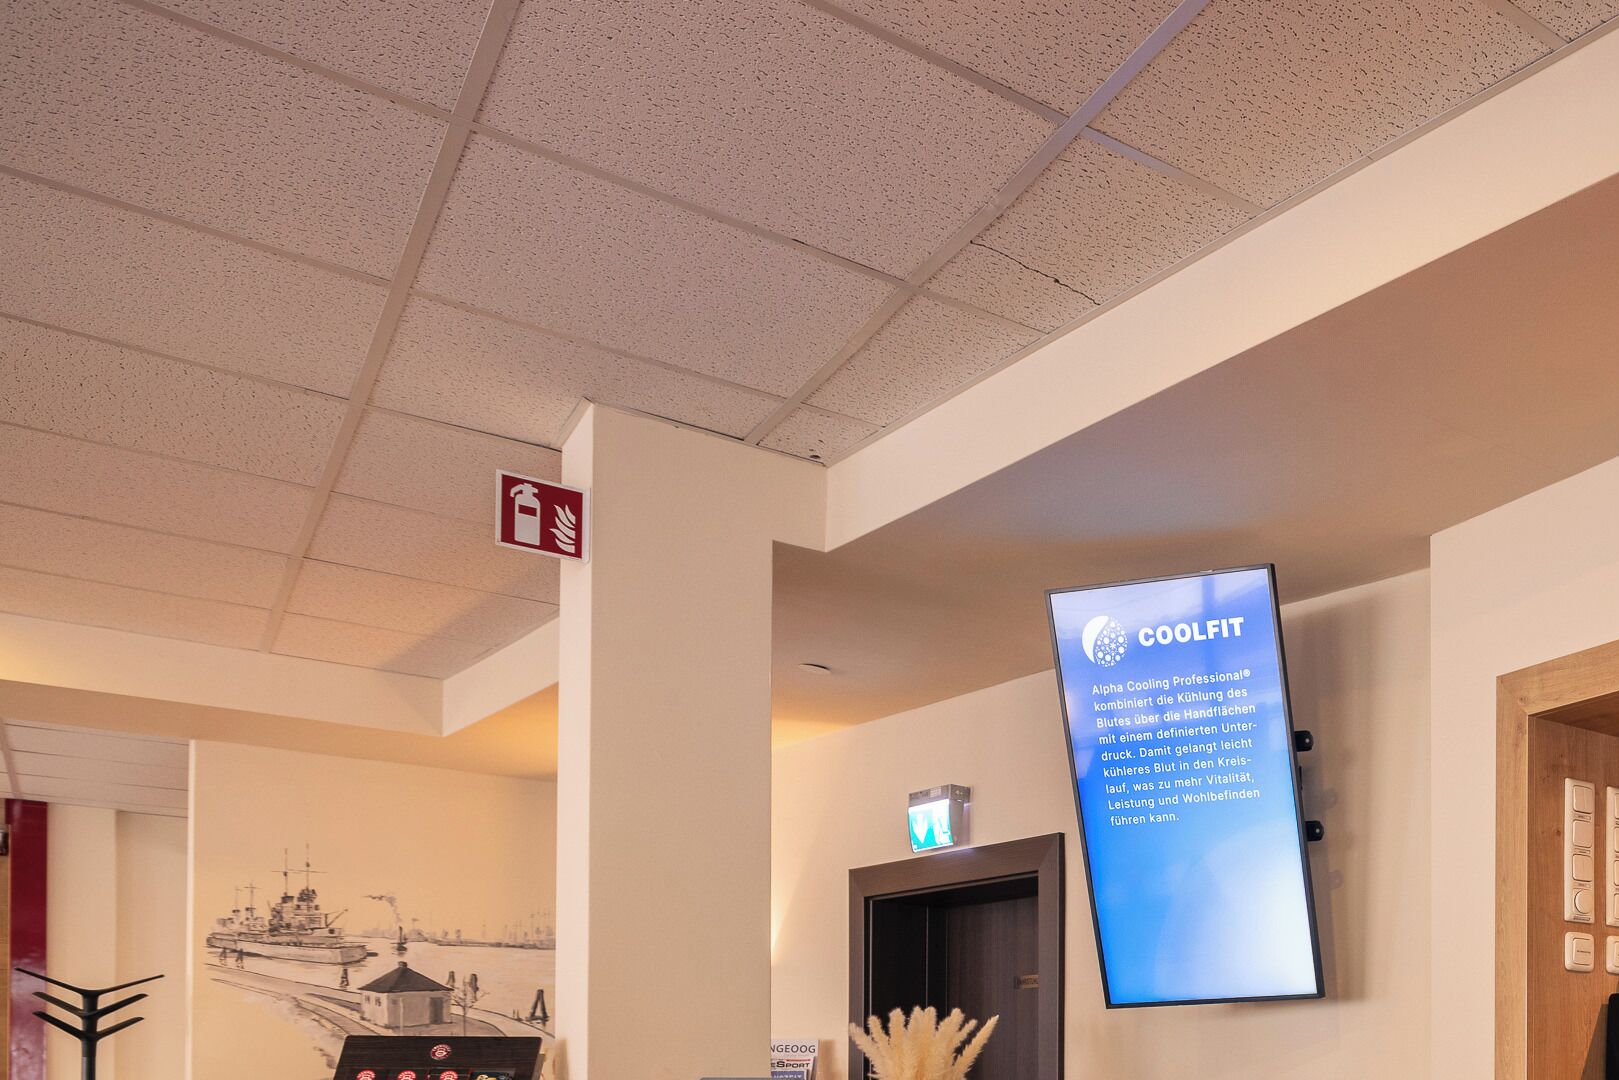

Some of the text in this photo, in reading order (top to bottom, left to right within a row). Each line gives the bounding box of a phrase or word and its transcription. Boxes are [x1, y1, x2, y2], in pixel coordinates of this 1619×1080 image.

[1138, 617, 1244, 647] COOLFIT
[1092, 683, 1123, 696] Alpha
[1127, 677, 1170, 692] Cooling
[1094, 687, 1248, 712] kombiniert die Kühlung des
[1096, 704, 1256, 728] Blutes über die Handflächen
[1099, 722, 1257, 745] mit einem definierten Unter-
[1101, 738, 1253, 761] druck. Damit gelangt leicht
[1103, 755, 1252, 777] kühleres Blut in den Kreis-
[1105, 770, 1255, 794] lauf, was zu mehr Vitalität,
[1108, 788, 1260, 811] Leistung und Wohlbefinden
[1110, 811, 1180, 826] führen kann.
